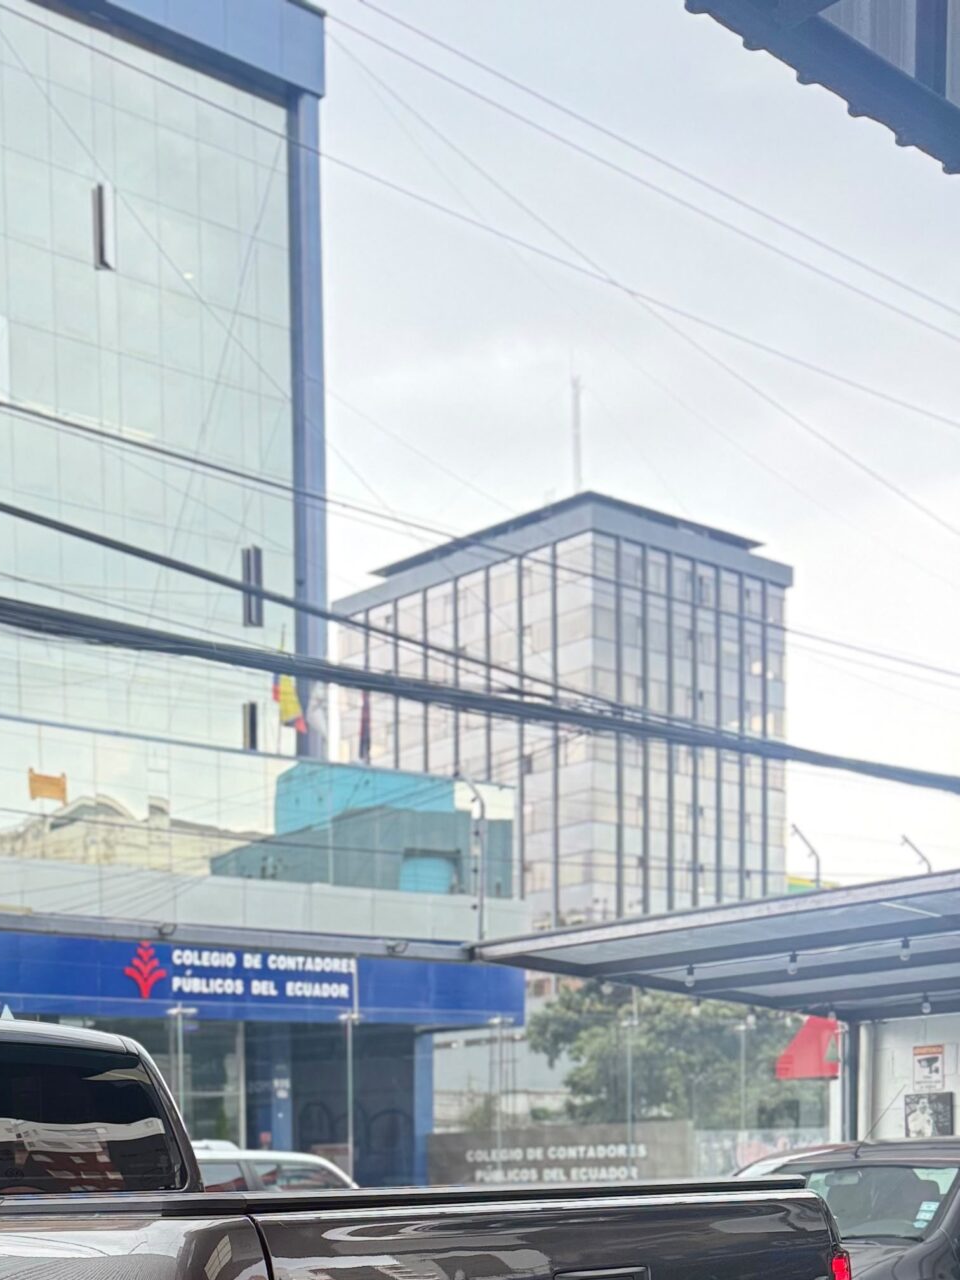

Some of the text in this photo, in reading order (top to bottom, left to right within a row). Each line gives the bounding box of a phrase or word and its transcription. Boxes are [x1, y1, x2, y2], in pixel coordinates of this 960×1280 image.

[172, 949, 356, 973] COLEGIO DE CONTADORES
[171, 969, 349, 998] PÚBLICOS DEL ECUADOR
[465, 1144, 647, 1162] COLEGIO DE CONTADORES
[543, 1167, 567, 1182] DEL
